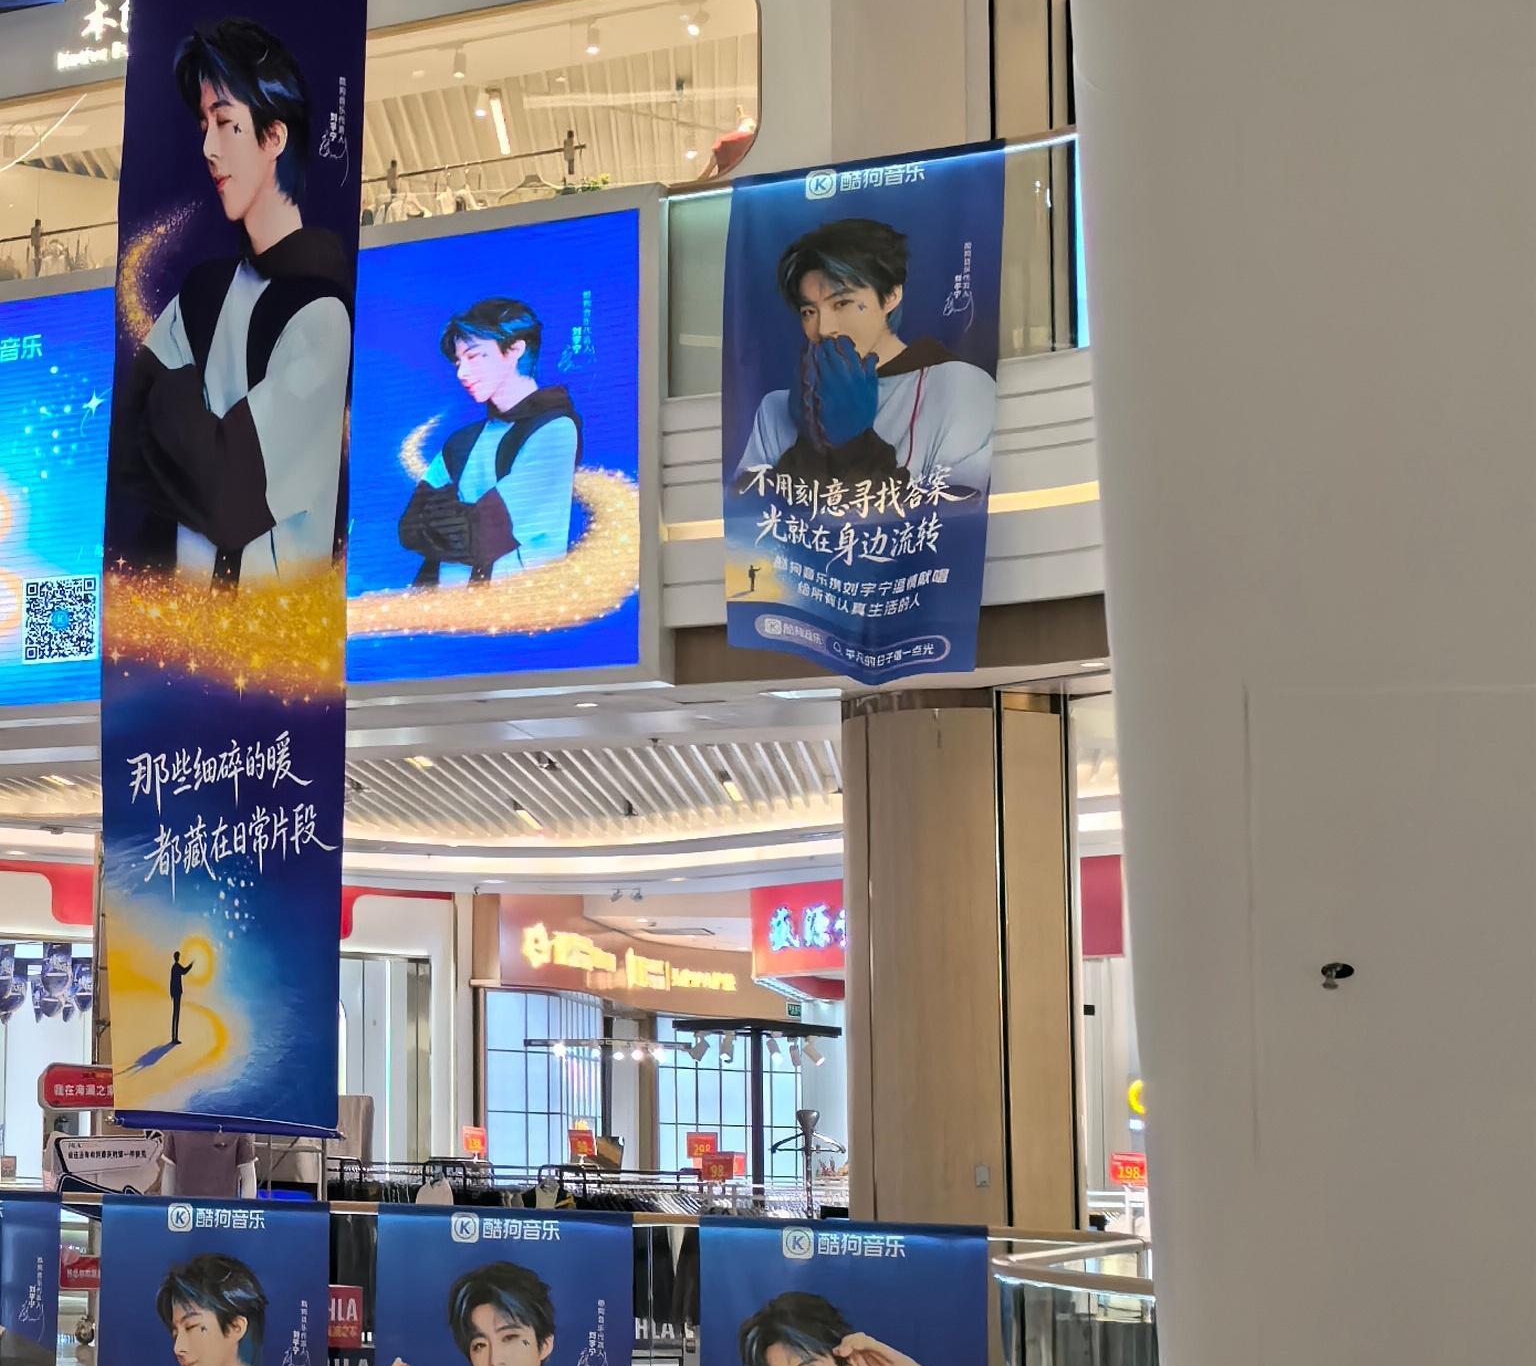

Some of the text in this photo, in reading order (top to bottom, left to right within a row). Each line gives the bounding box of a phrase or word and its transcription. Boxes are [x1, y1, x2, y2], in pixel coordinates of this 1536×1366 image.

[840, 163, 926, 191] 酷狗音乐
[739, 464, 981, 521] 不用刻意寻找答案
[756, 510, 941, 573] 光就在身边流转
[127, 730, 312, 814] 那些细碎的暖
[144, 803, 338, 903] 都藏在日常片段
[196, 1206, 265, 1229] 酷狗音乐
[483, 1217, 560, 1241] 酷狗音乐
[818, 1233, 906, 1259] 酷狗音乐
[635, 1317, 674, 1339] HLA
